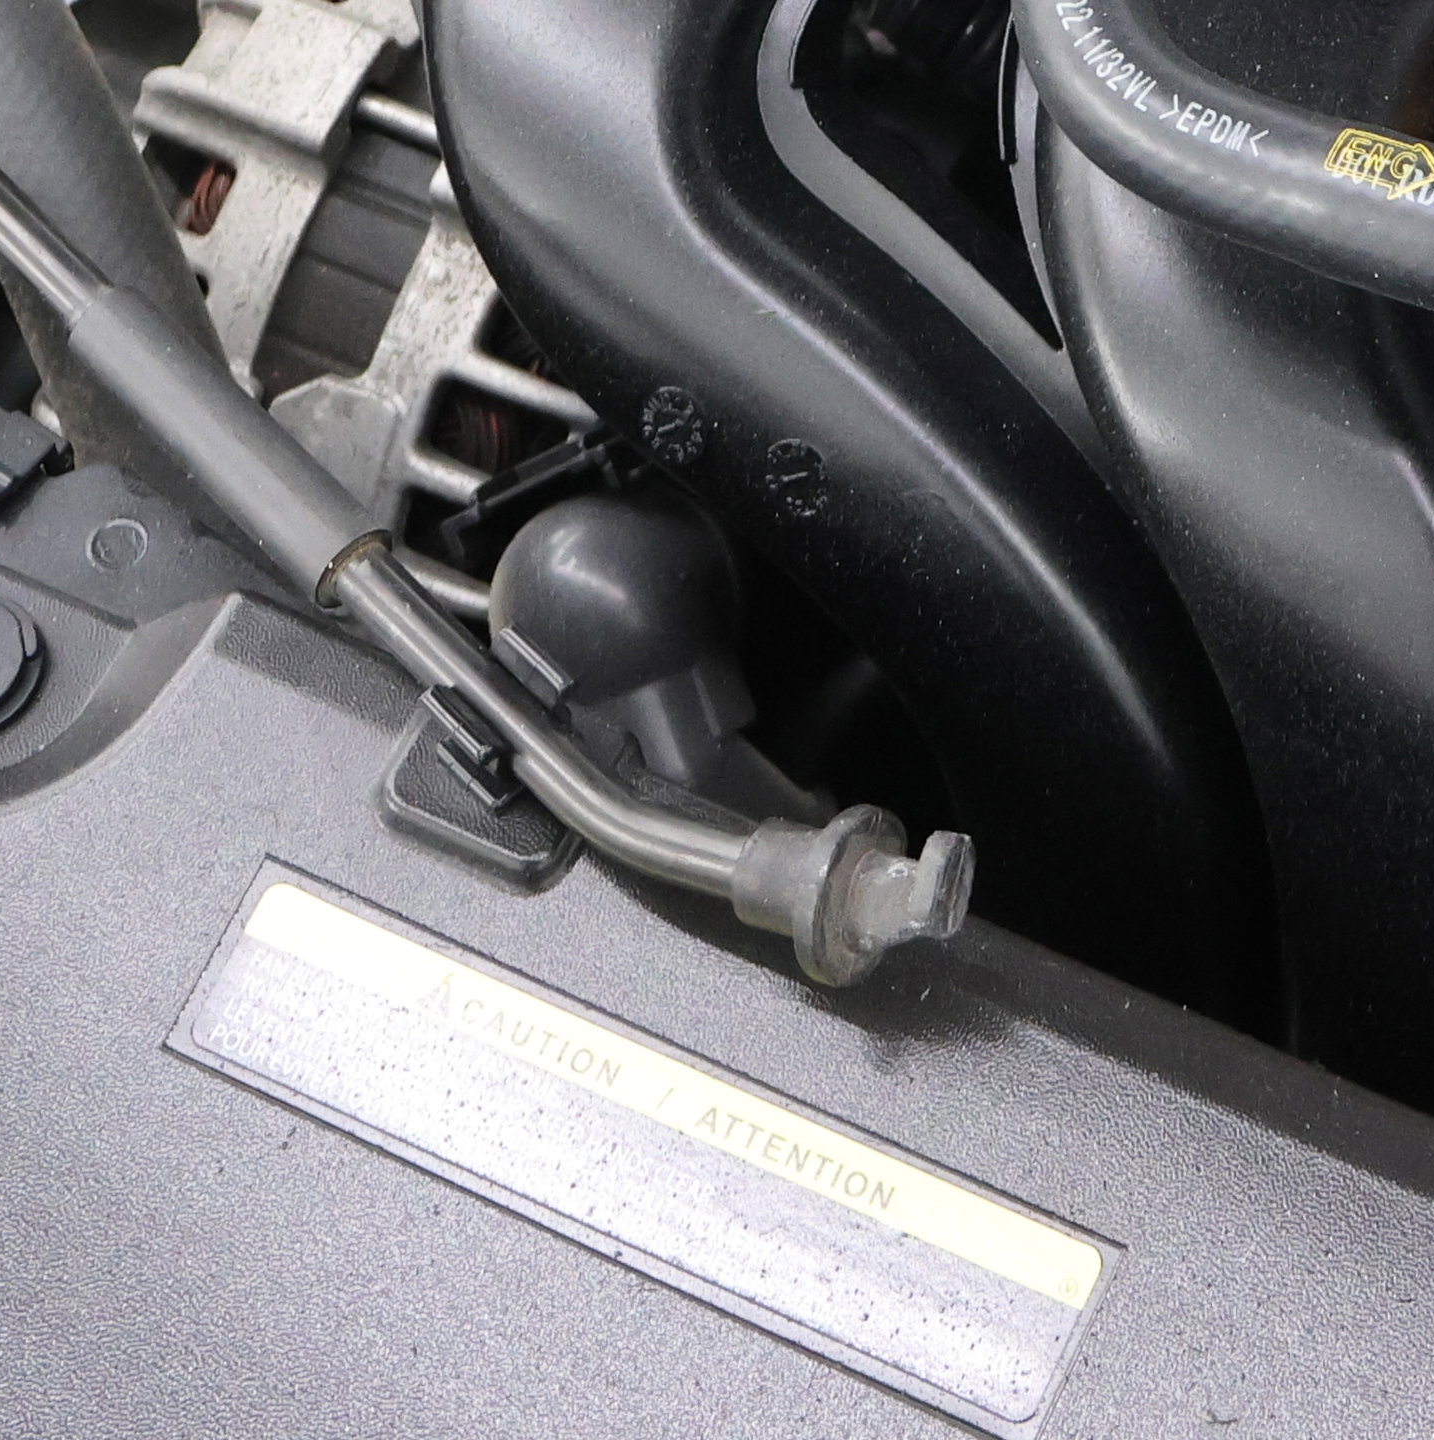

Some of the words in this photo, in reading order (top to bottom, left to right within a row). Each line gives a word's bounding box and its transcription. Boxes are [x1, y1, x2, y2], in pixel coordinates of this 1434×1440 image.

[1346, 137, 1419, 179] ENG
[463, 997, 623, 1088] CAUTION
[695, 1106, 897, 1211] ATTENTION
